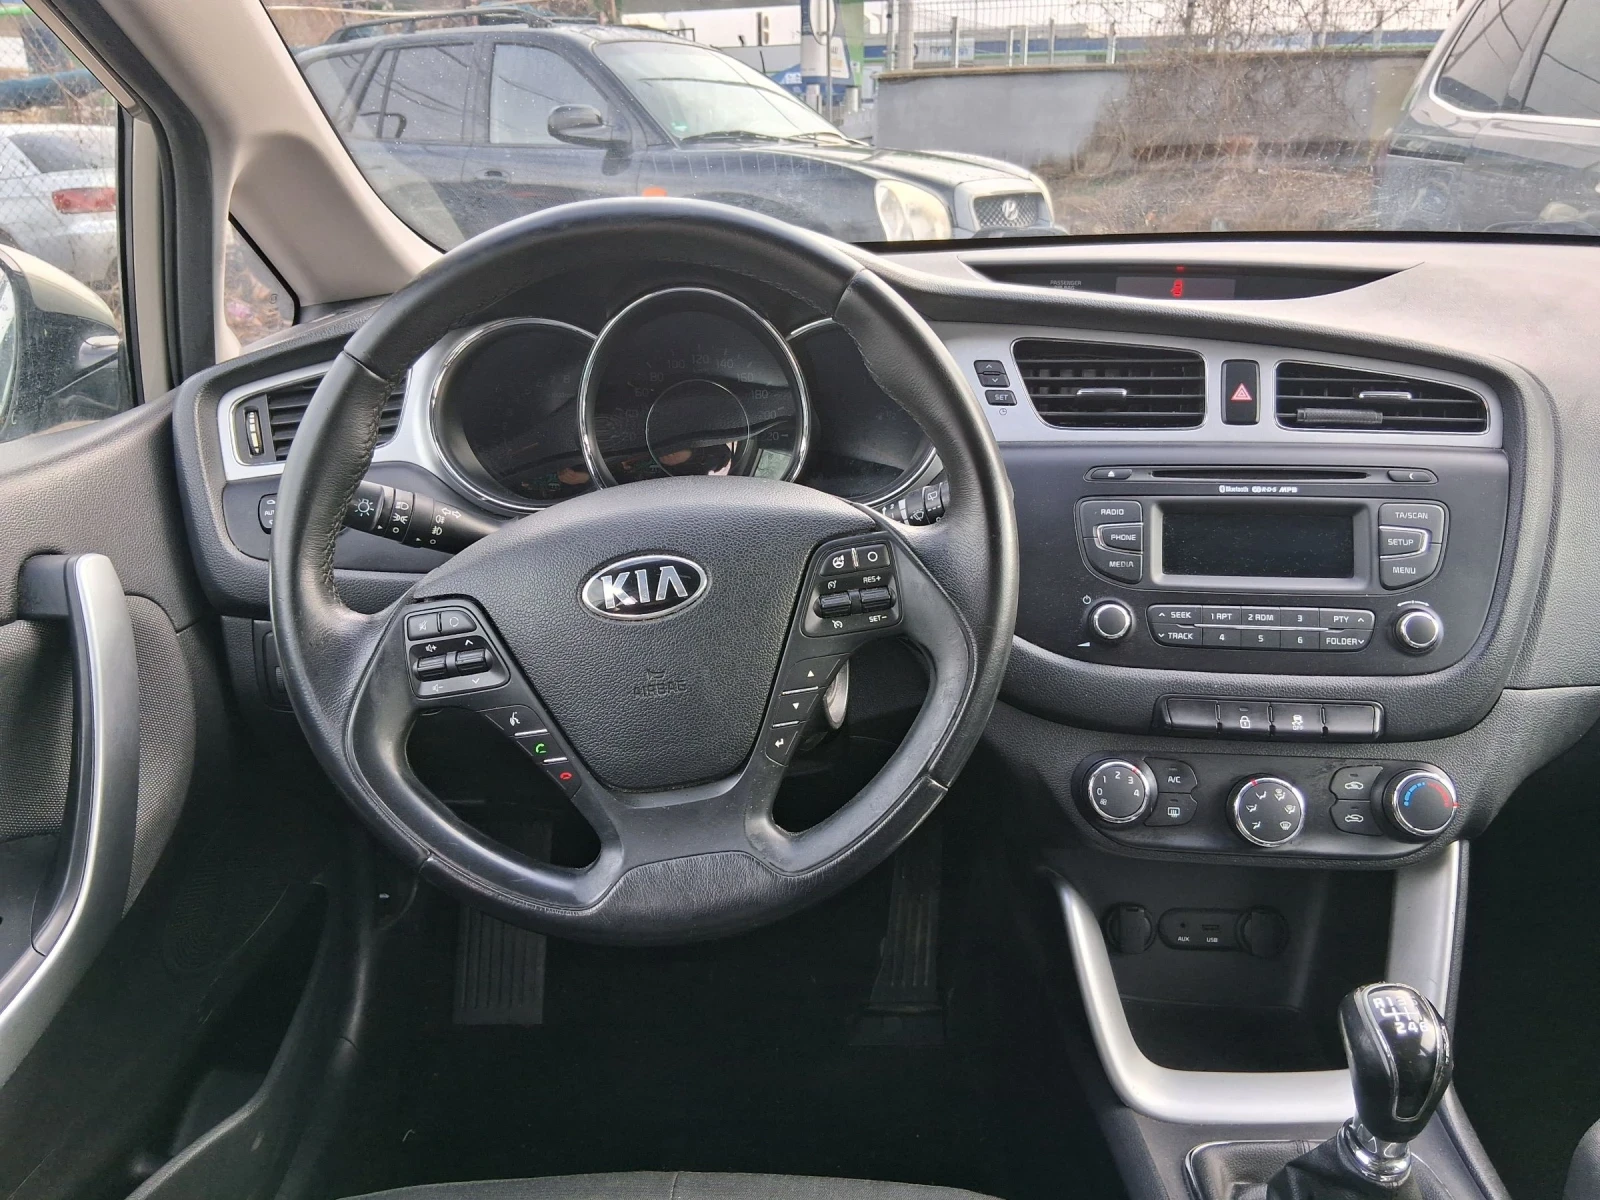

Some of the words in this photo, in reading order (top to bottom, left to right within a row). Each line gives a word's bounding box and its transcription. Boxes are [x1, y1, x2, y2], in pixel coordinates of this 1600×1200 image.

[692, 354, 710, 364] 120
[667, 360, 686, 369] 100
[1100, 508, 1125, 516] RADIO
[1387, 538, 1414, 546] SETUP
[1109, 560, 1134, 568] MEDIA
[1392, 566, 1416, 574] MENU
[863, 575, 881, 584] RES+
[601, 565, 689, 609] KIA
[1170, 611, 1192, 619] SEEK
[1247, 613, 1254, 621] 2
[1333, 615, 1349, 623] PTY
[1168, 632, 1194, 640] TRACK
[1218, 633, 1225, 641] 4
[1258, 634, 1264, 642] 5
[1297, 636, 1303, 644] 6
[1326, 637, 1358, 646] FOLDER
[1115, 771, 1121, 779] 2
[1128, 776, 1134, 785] 3
[1167, 775, 1181, 784] A/C
[1096, 787, 1103, 796] 0
[1133, 789, 1140, 797] 4
[1372, 997, 1386, 1009] R
[1385, 996, 1394, 1007] 1
[1394, 1021, 1407, 1035] 2
[1407, 1021, 1419, 1033] 4
